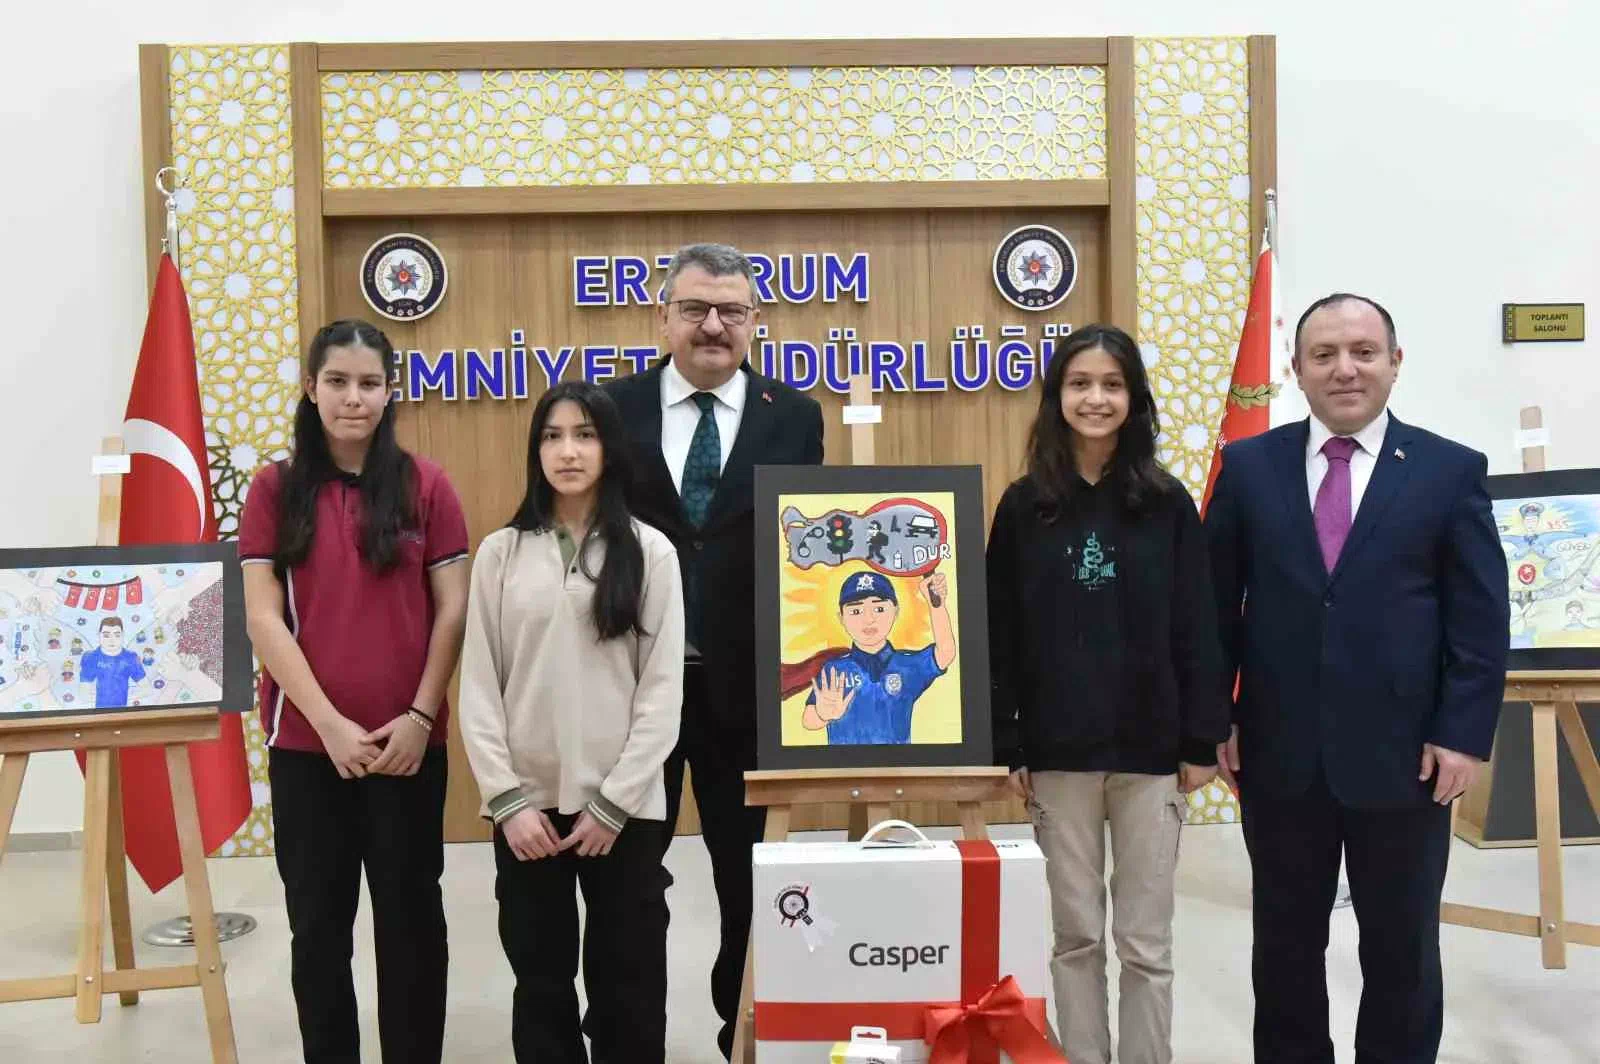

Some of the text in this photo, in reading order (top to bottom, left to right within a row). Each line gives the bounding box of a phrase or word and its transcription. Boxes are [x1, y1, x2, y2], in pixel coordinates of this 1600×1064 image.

[574, 252, 870, 306] ERRUM
[1530, 313, 1568, 321] TOPLANTI
[1534, 324, 1566, 332] SALONU
[747, 323, 1072, 393] DÜRLÜĞ
[912, 543, 951, 566] DUR
[849, 942, 950, 972] Casper
